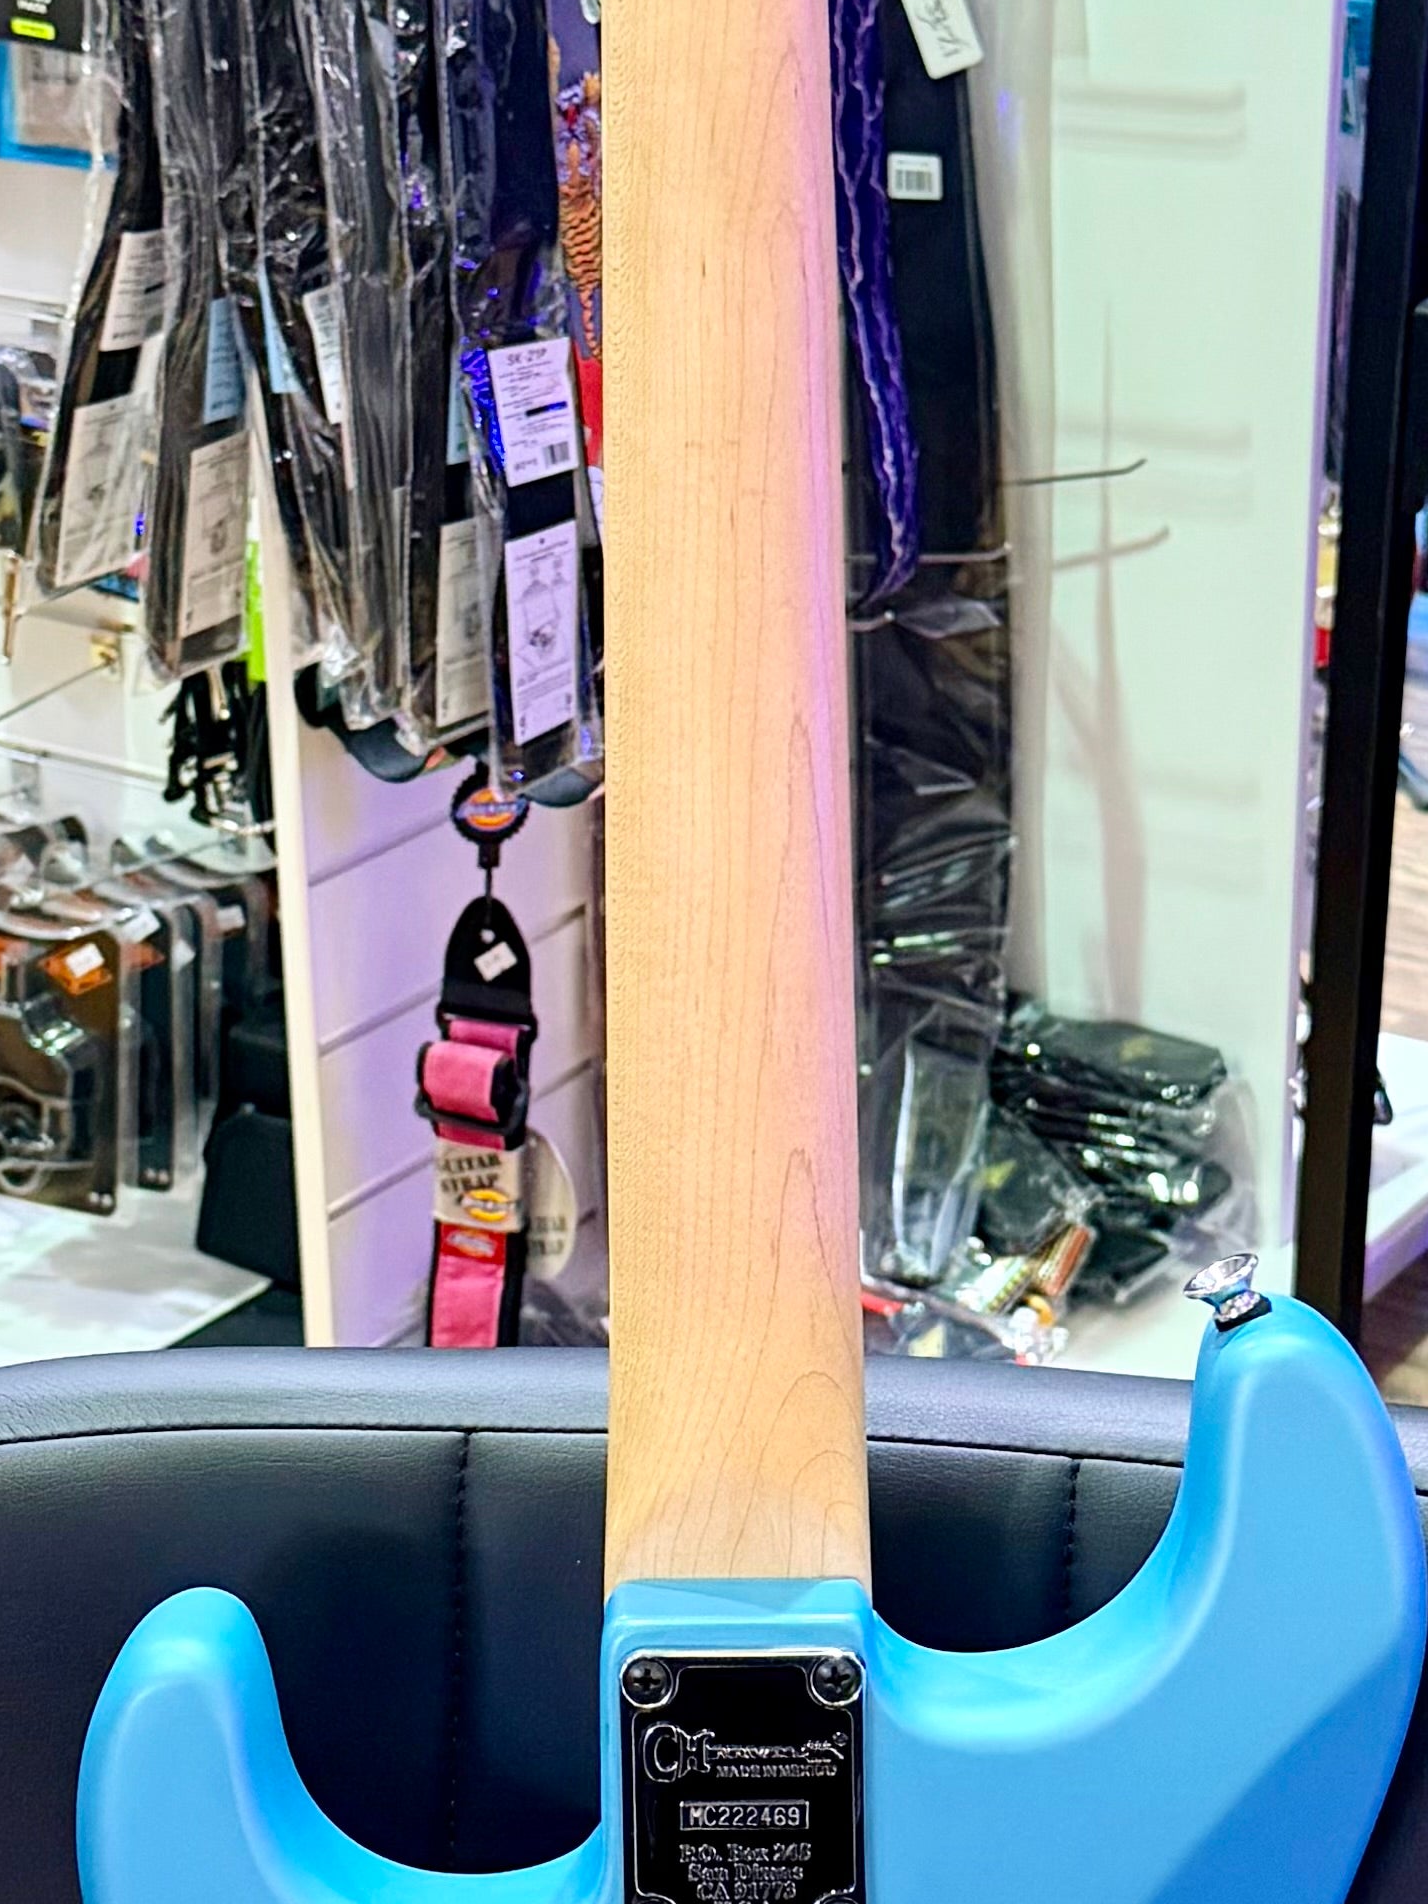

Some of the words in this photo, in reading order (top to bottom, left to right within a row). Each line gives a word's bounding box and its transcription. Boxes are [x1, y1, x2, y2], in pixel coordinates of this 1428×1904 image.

[716, 1764, 761, 1778] MADE
[762, 1764, 777, 1778] IN
[778, 1763, 838, 1778] MEXICO
[689, 1805, 801, 1827] MC222469
[679, 1843, 722, 1863] P.O.
[727, 1843, 770, 1862] Box
[688, 1863, 729, 1882] San
[733, 1862, 804, 1881] Dimas
[696, 1881, 730, 1900] CA
